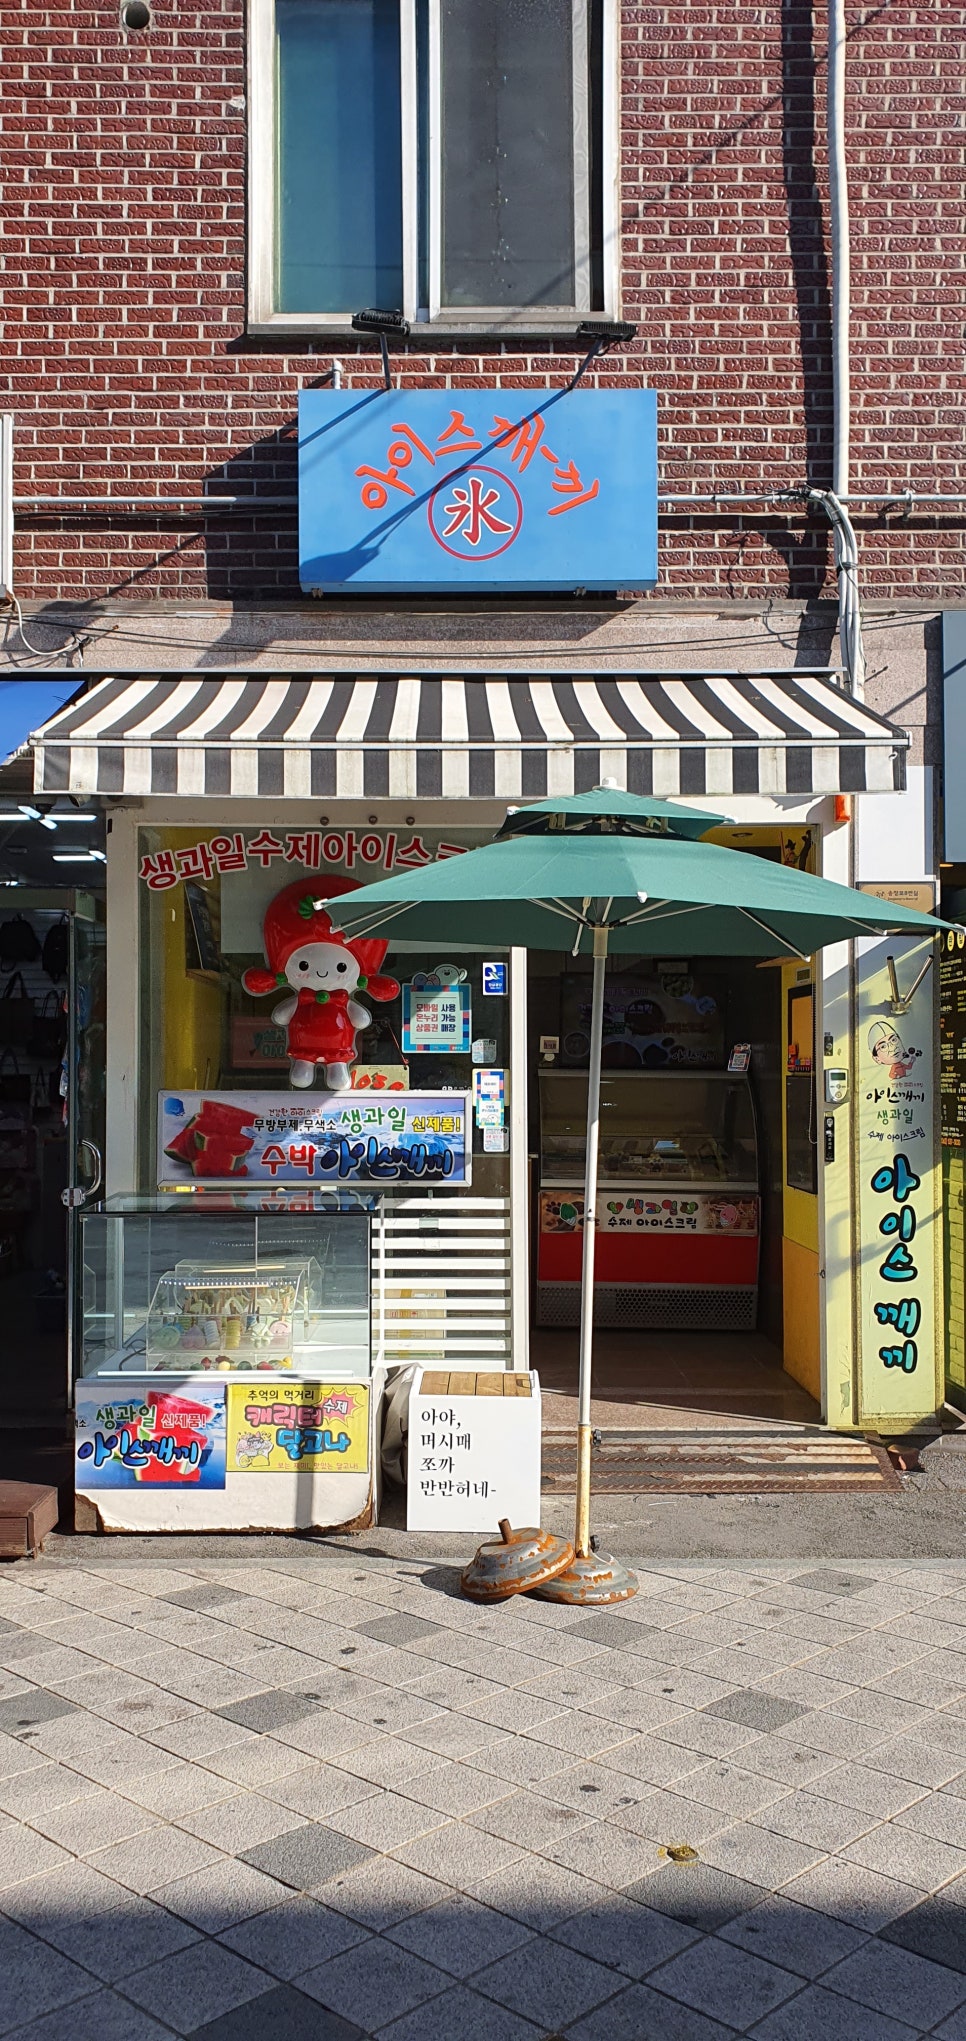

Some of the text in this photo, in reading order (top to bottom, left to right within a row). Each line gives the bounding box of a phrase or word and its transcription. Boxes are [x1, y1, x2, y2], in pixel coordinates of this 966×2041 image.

[442, 477, 514, 546] 氷
[139, 829, 481, 891] 생과일수제아이스
[416, 1004, 456, 1012] 모바일 사용
[416, 1014, 456, 1022] 온누리 가능
[416, 1024, 456, 1032] 상품권 매장
[340, 1106, 407, 1134] 생과일
[412, 1117, 460, 1132] 신제품!
[877, 1109, 913, 1125] 생과일
[260, 1145, 318, 1177] 수박
[608, 1217, 697, 1229] 수제 아이스크림
[247, 1390, 314, 1401] 추억의 먹거리
[244, 1403, 323, 1429] 캐릭터
[323, 1400, 348, 1414] 수제
[96, 1404, 156, 1430] 생과일
[421, 1408, 461, 1430] 아야,
[276, 1428, 351, 1460] 달고나
[420, 1432, 471, 1450] 머시매
[420, 1456, 455, 1473] 쪼까
